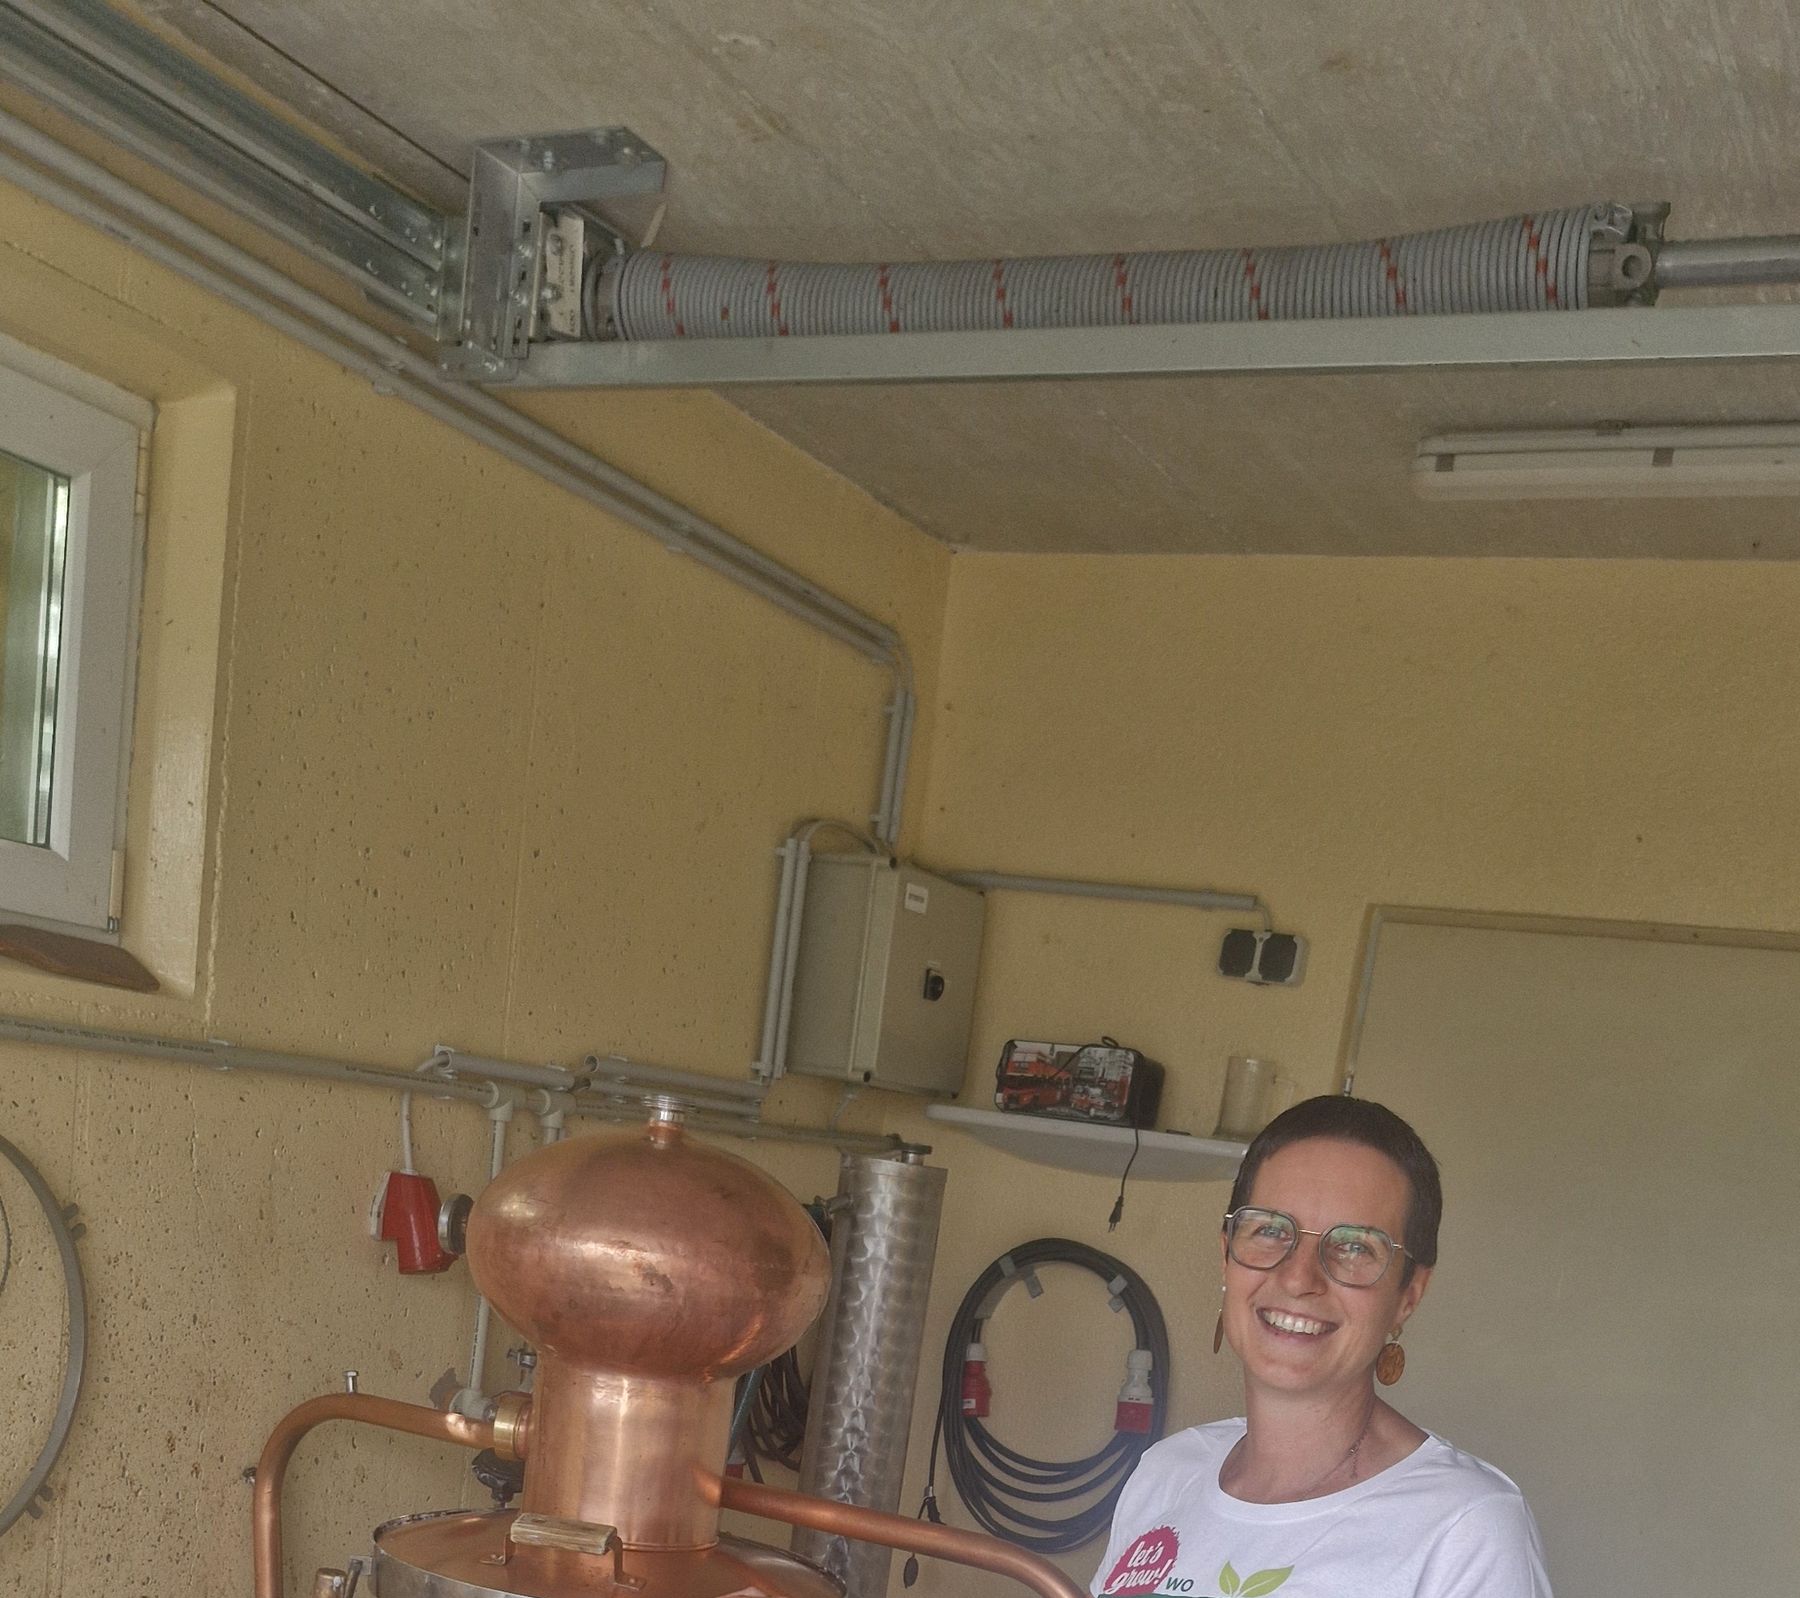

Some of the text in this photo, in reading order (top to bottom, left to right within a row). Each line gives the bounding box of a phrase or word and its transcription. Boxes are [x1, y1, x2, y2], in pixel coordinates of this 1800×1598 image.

[1127, 1541, 1165, 1568] let's
[1104, 1558, 1174, 1595] grow!
[1165, 1576, 1194, 1593] WO
